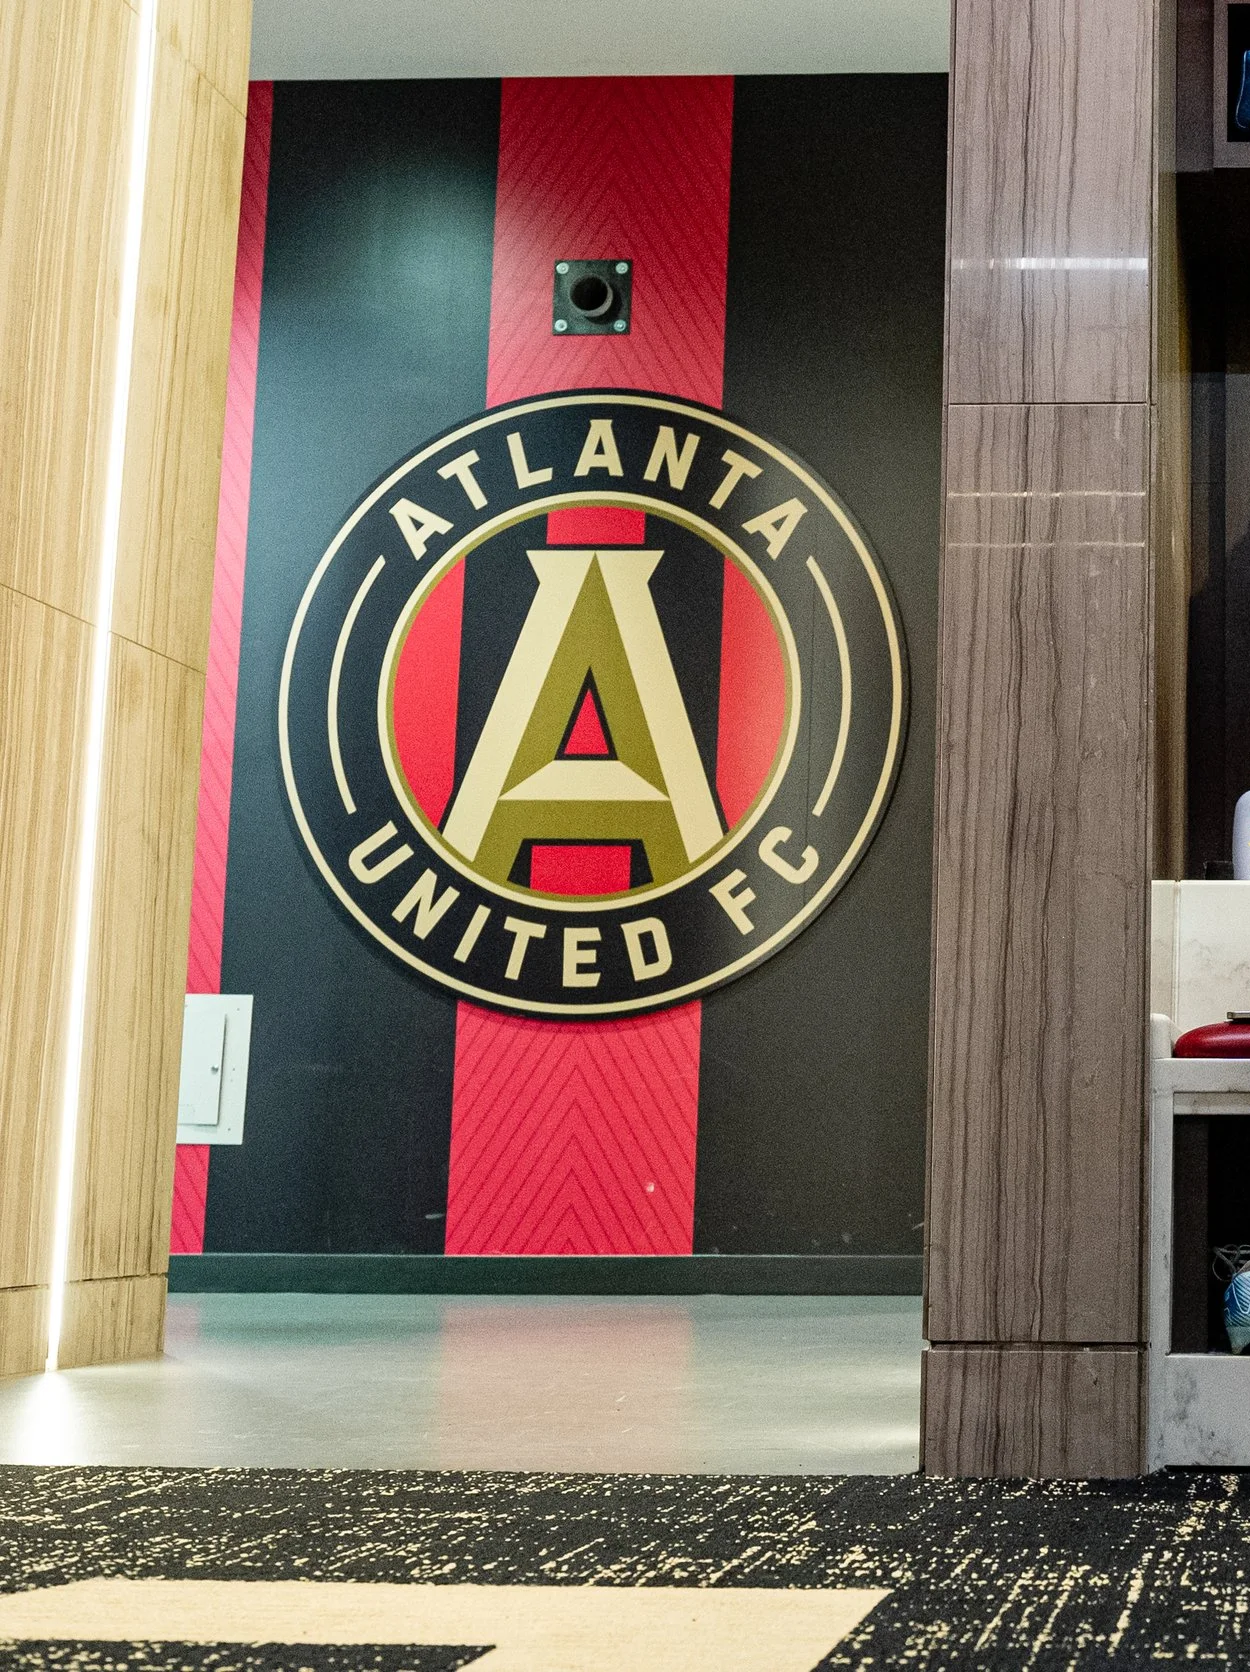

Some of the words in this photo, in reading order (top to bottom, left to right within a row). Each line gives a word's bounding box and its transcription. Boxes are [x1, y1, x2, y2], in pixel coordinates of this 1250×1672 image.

[388, 418, 808, 562] ATLANTA
[348, 820, 673, 988] UNITED
[709, 825, 820, 935] FC
